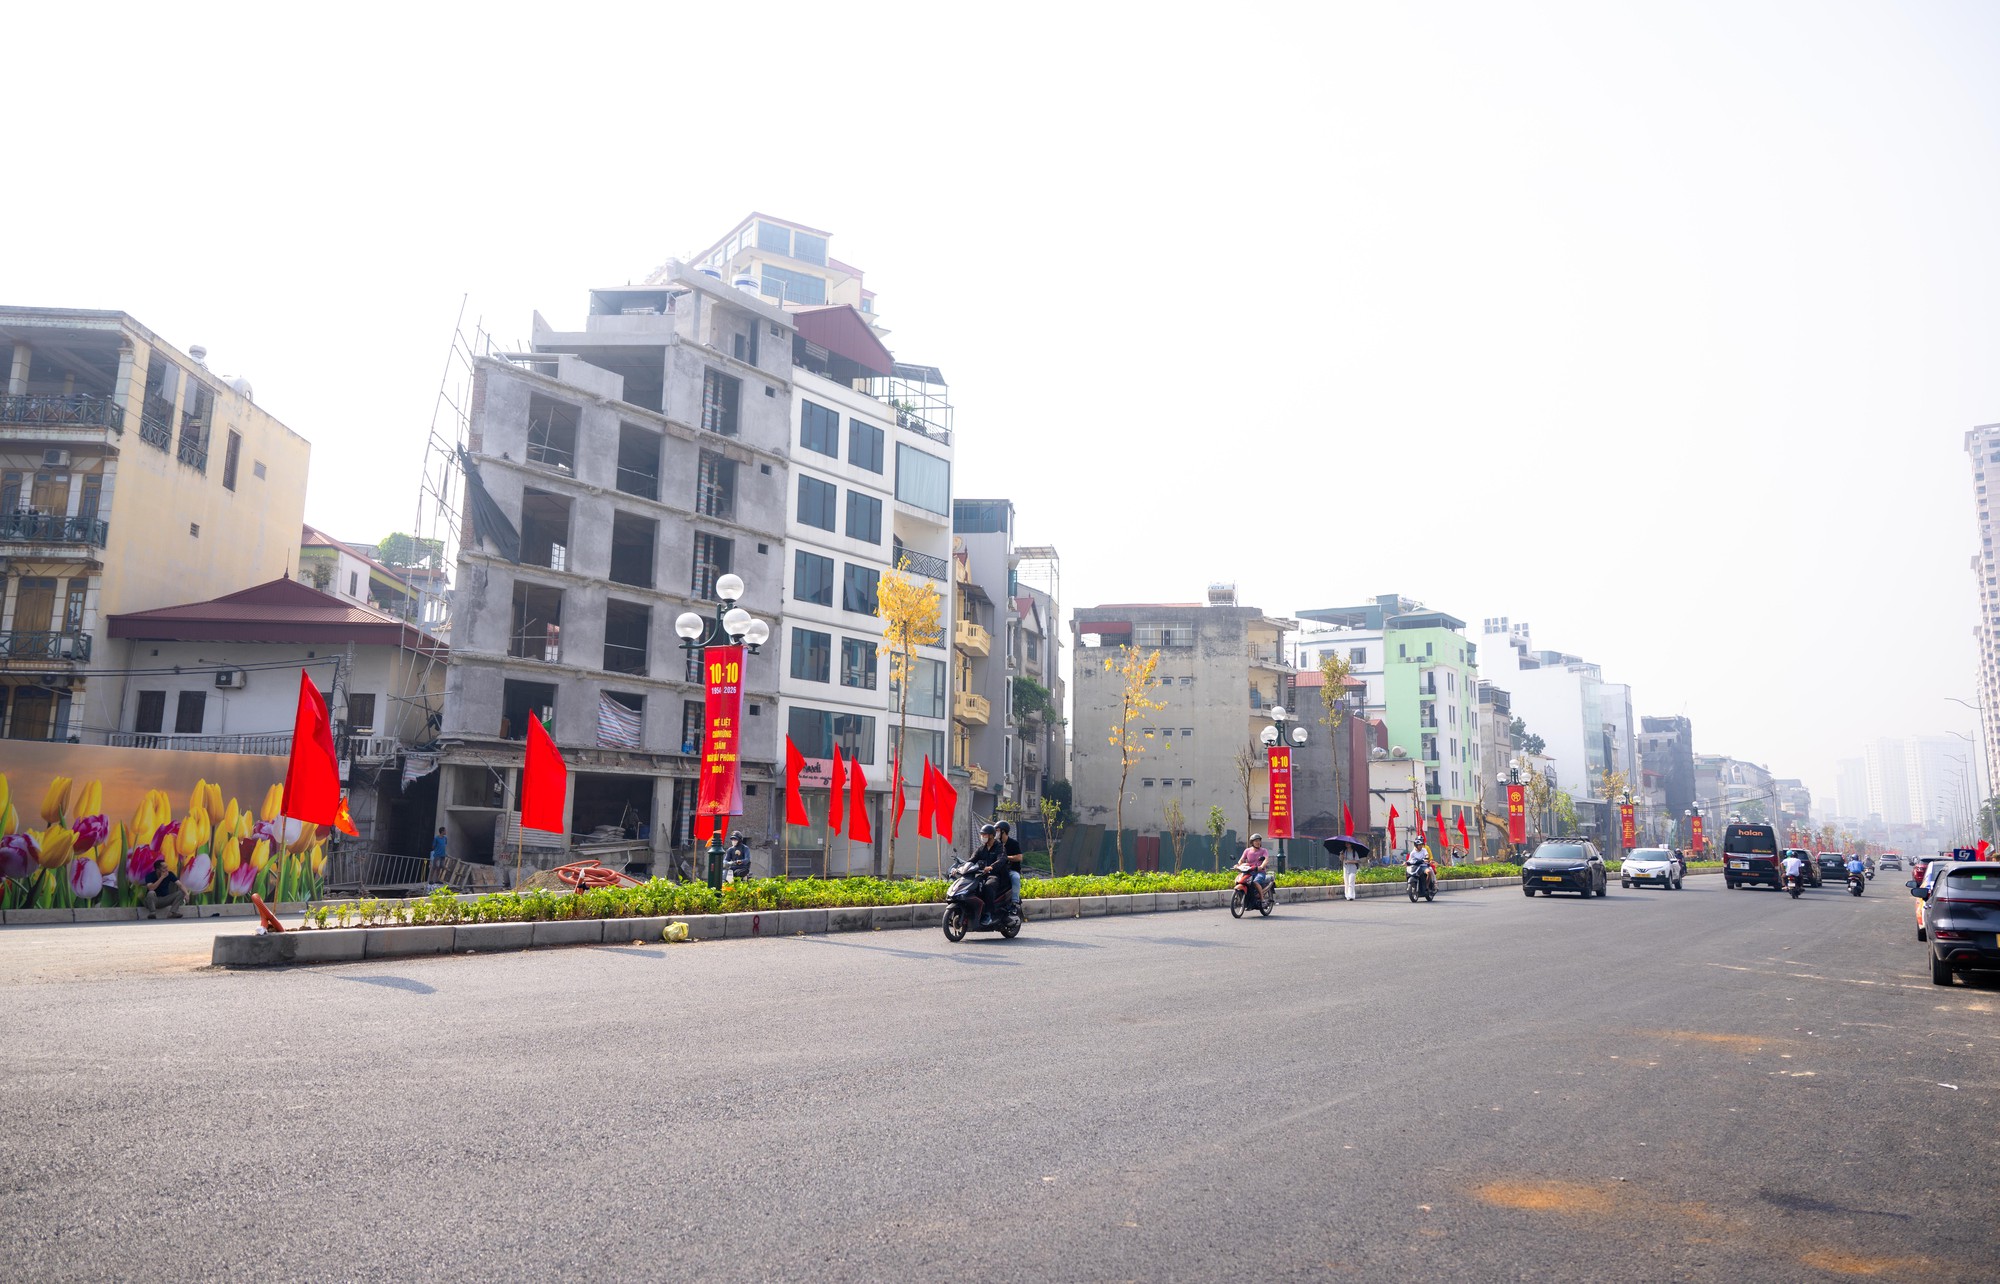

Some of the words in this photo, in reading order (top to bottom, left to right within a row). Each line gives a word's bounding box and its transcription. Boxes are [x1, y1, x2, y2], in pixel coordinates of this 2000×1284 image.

[709, 662, 739, 684] 10-10
[1270, 755, 1289, 768] 10-10
[1738, 829, 1764, 837] halan
